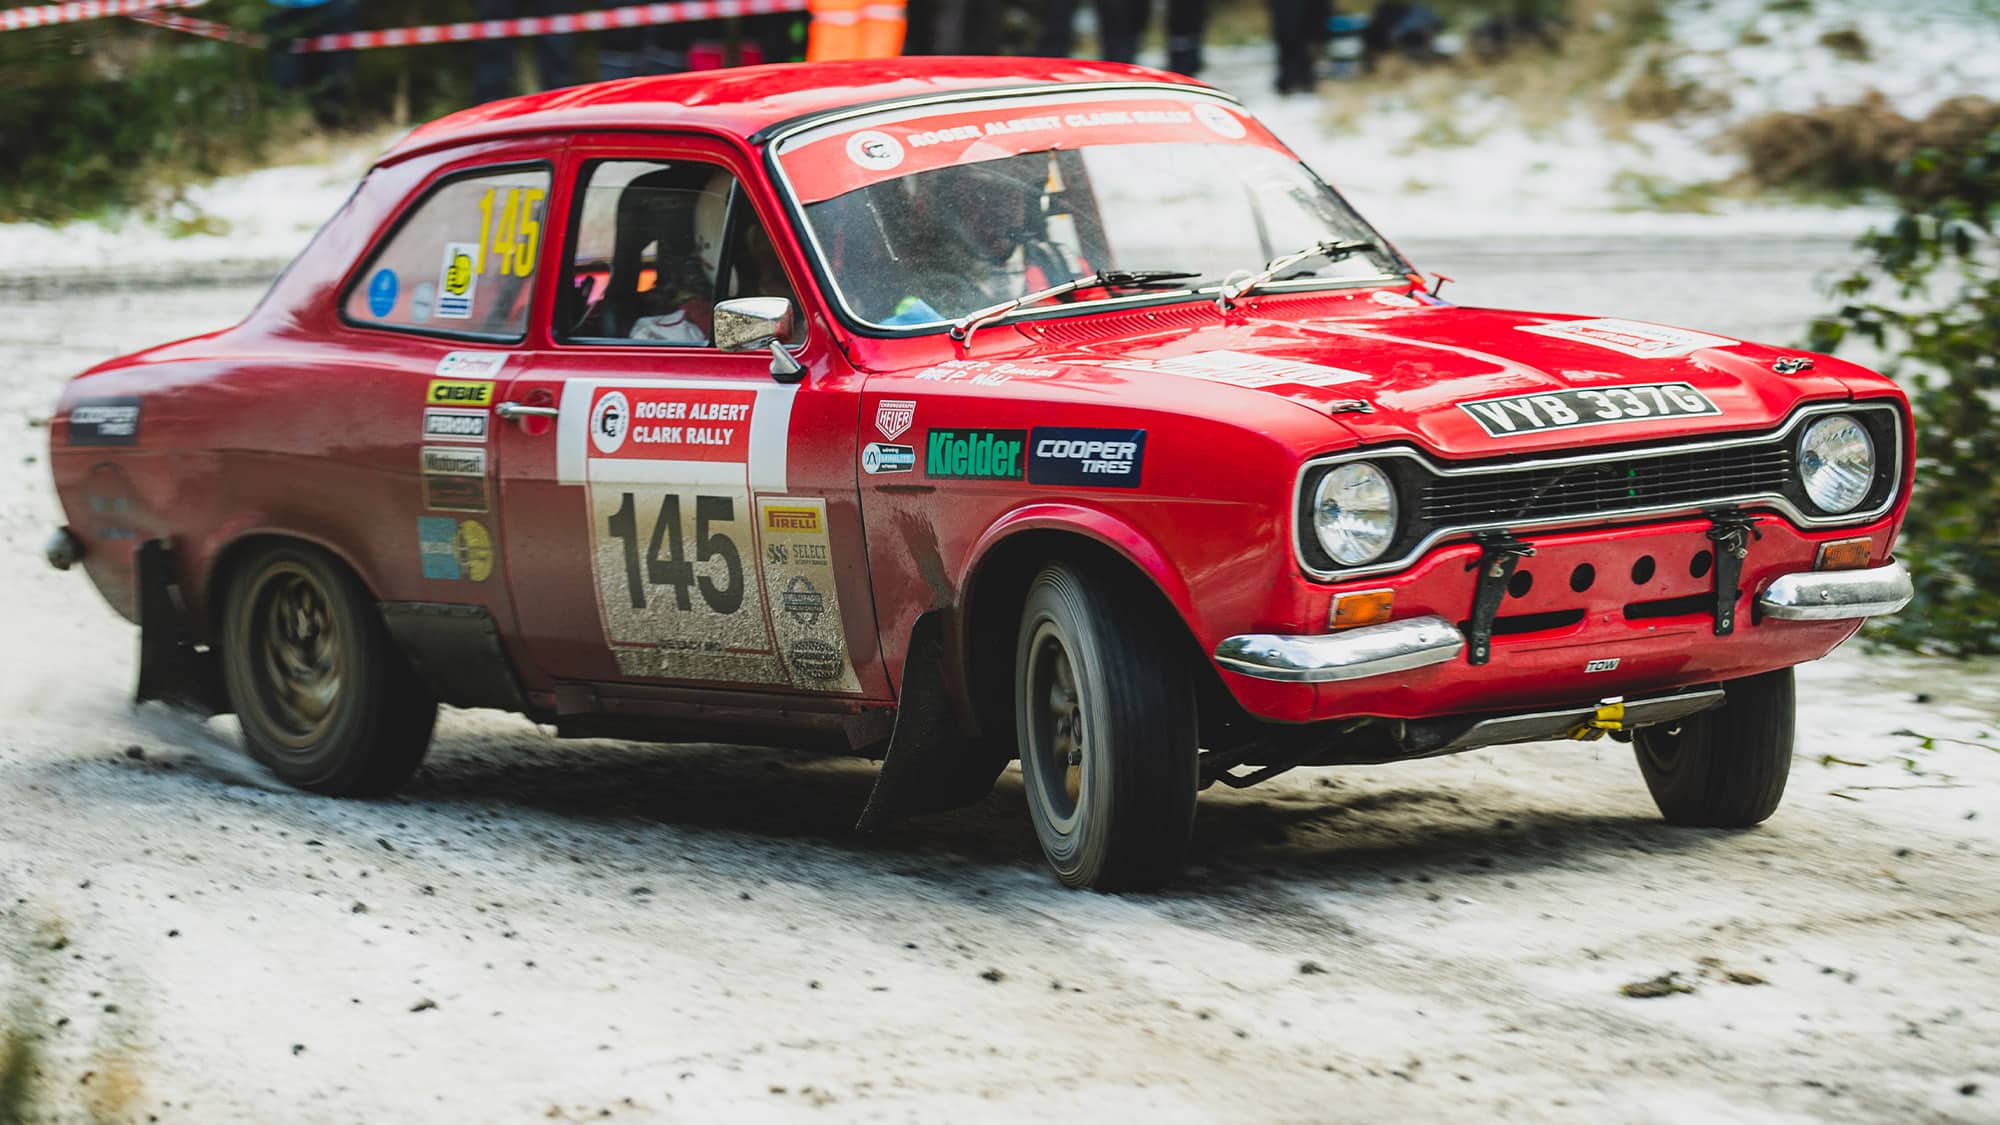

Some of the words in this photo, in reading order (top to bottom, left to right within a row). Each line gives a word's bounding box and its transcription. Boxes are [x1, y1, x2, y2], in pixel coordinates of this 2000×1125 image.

[906, 125, 984, 148] ROGER
[984, 114, 1062, 136] ALBERT
[477, 189, 545, 277] 145
[635, 401, 687, 419] ROGER
[689, 403, 750, 421] ALBERT
[1470, 395, 1579, 431] VYB
[1577, 386, 1706, 420] 337G
[880, 411, 909, 434] HEUER
[632, 425, 683, 443] CLARK
[686, 427, 734, 446] RALLY
[1036, 440, 1137, 460] COOPER
[1081, 460, 1133, 475] TIRES
[768, 511, 816, 529] PIRELLI
[607, 492, 745, 614] 145
[792, 544, 826, 559] SELECT
[1587, 659, 1619, 672] TOW
